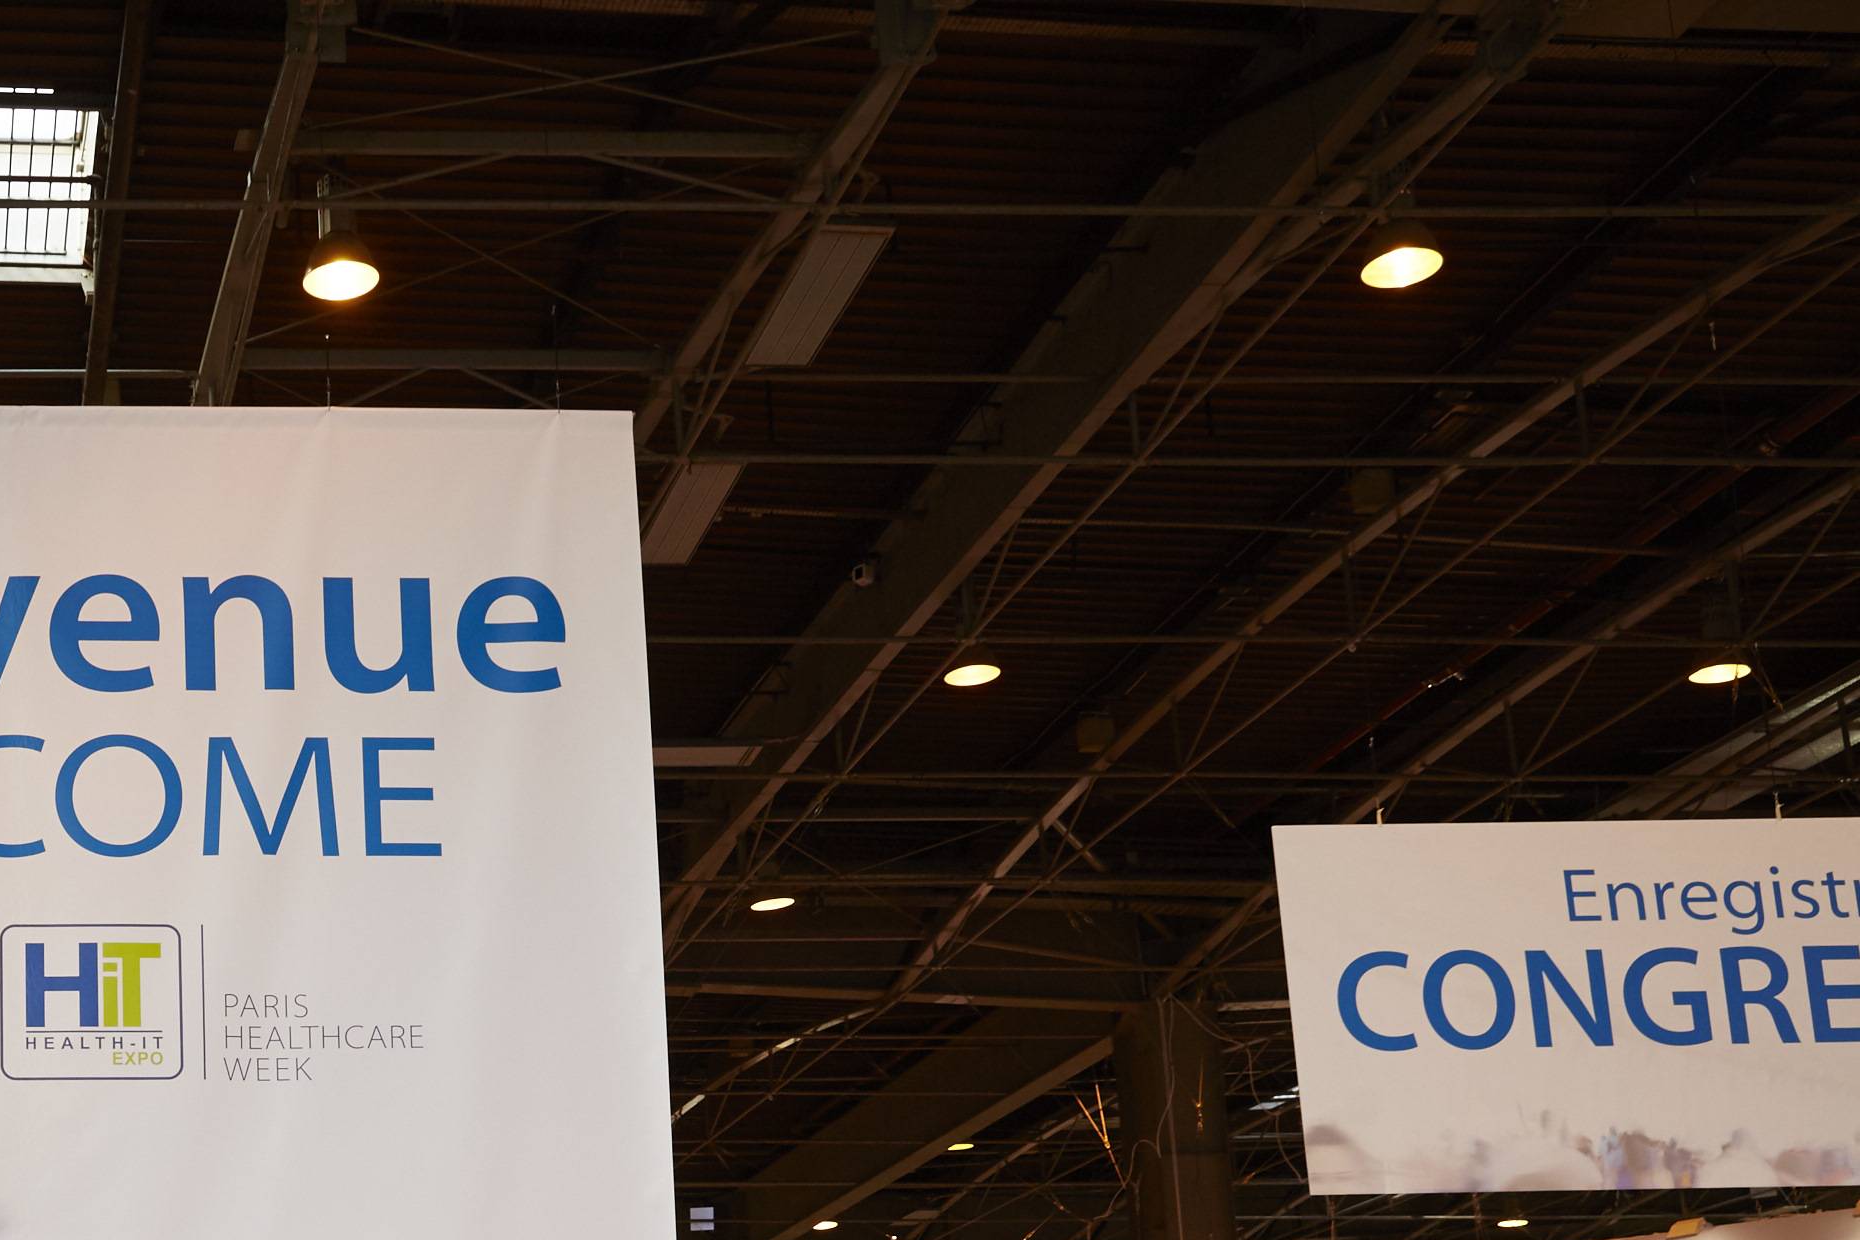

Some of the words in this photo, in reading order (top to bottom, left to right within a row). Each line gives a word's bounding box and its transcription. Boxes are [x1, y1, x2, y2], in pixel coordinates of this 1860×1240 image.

[1564, 866, 1860, 935] Enregist
[223, 993, 310, 1019] PARIS
[1338, 945, 1860, 1052] CONGRE
[25, 1035, 163, 1050] HEALTH-IT
[223, 1024, 425, 1050] HEALTHCARE
[112, 1051, 165, 1066] EXPO
[223, 1056, 312, 1082] WEEK
